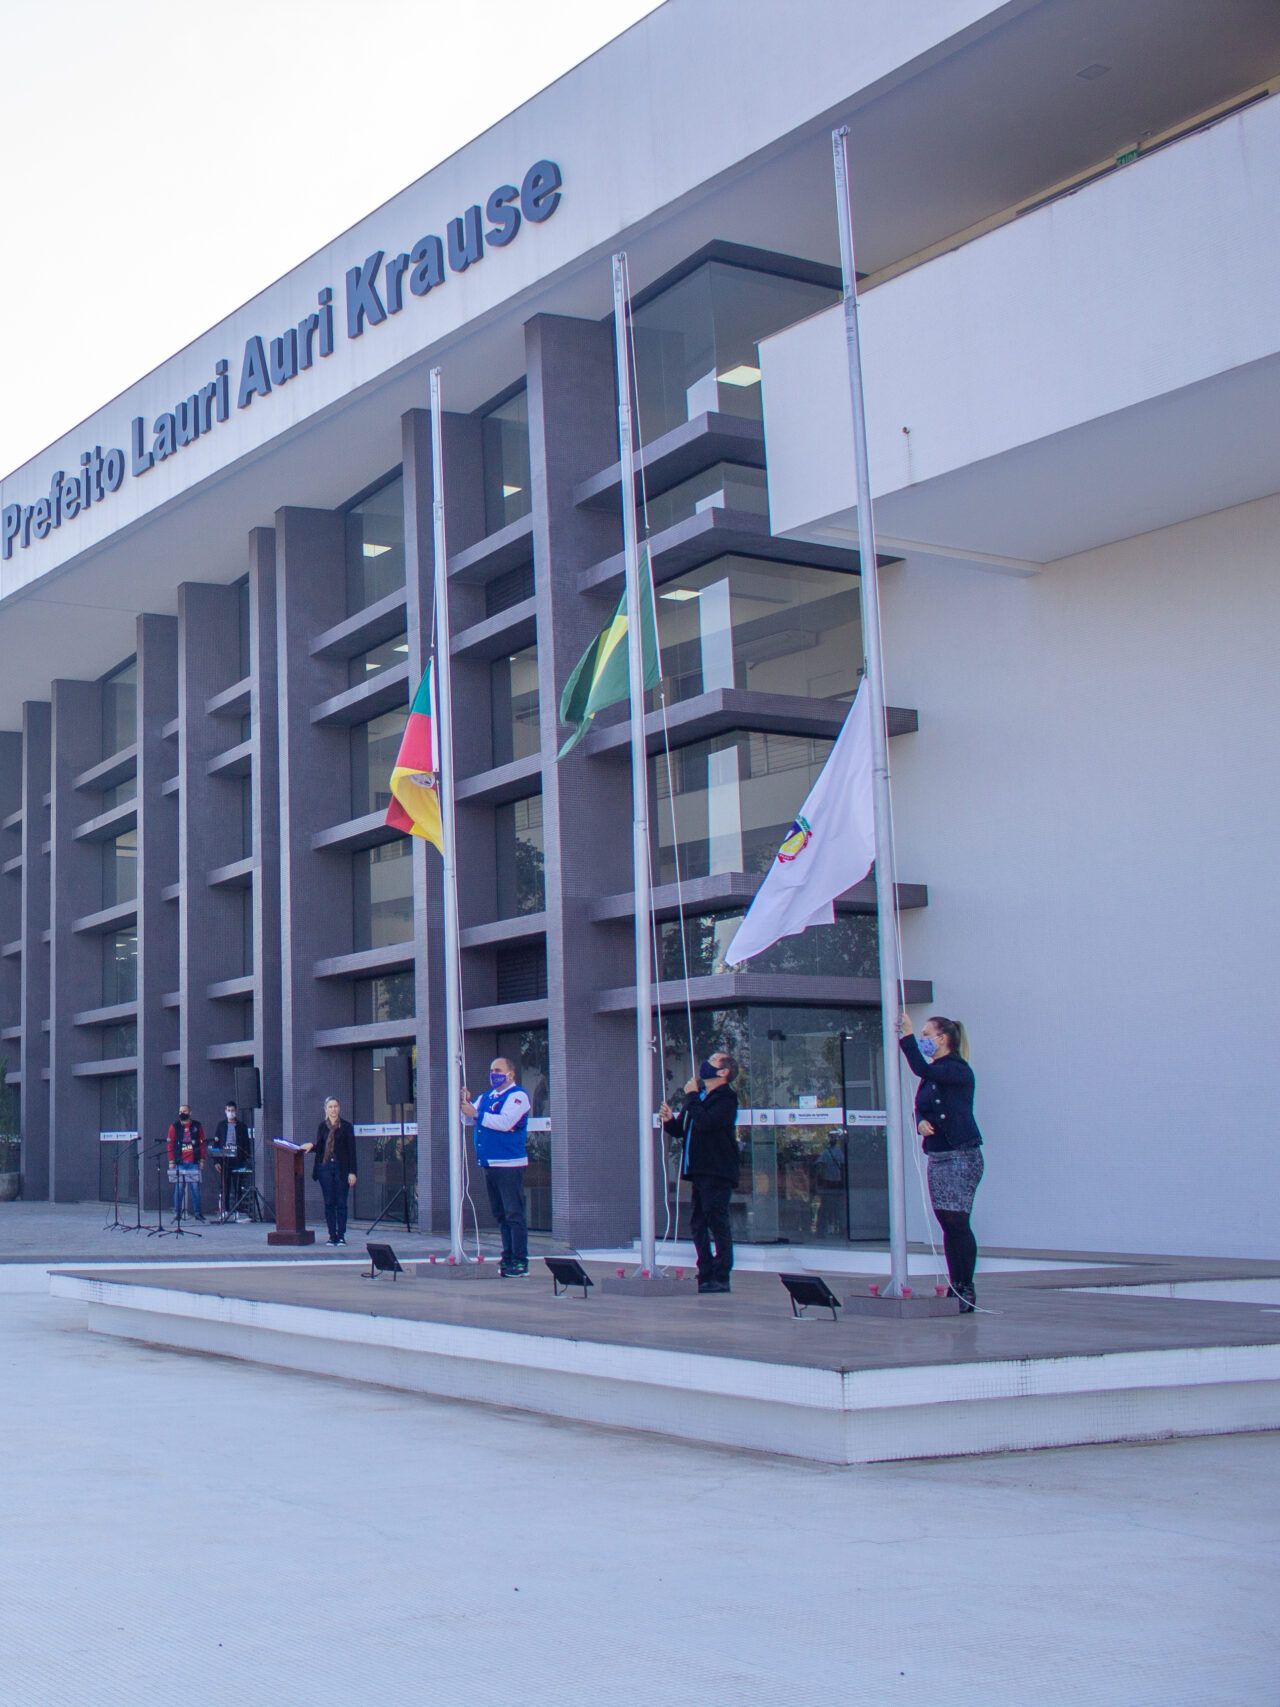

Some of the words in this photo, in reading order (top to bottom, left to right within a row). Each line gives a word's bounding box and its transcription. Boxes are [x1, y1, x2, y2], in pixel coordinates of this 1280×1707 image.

[1, 446, 125, 560] Prefeito
[131, 359, 230, 479] Lauri
[237, 287, 334, 409] Auri
[345, 159, 562, 339] Krause
